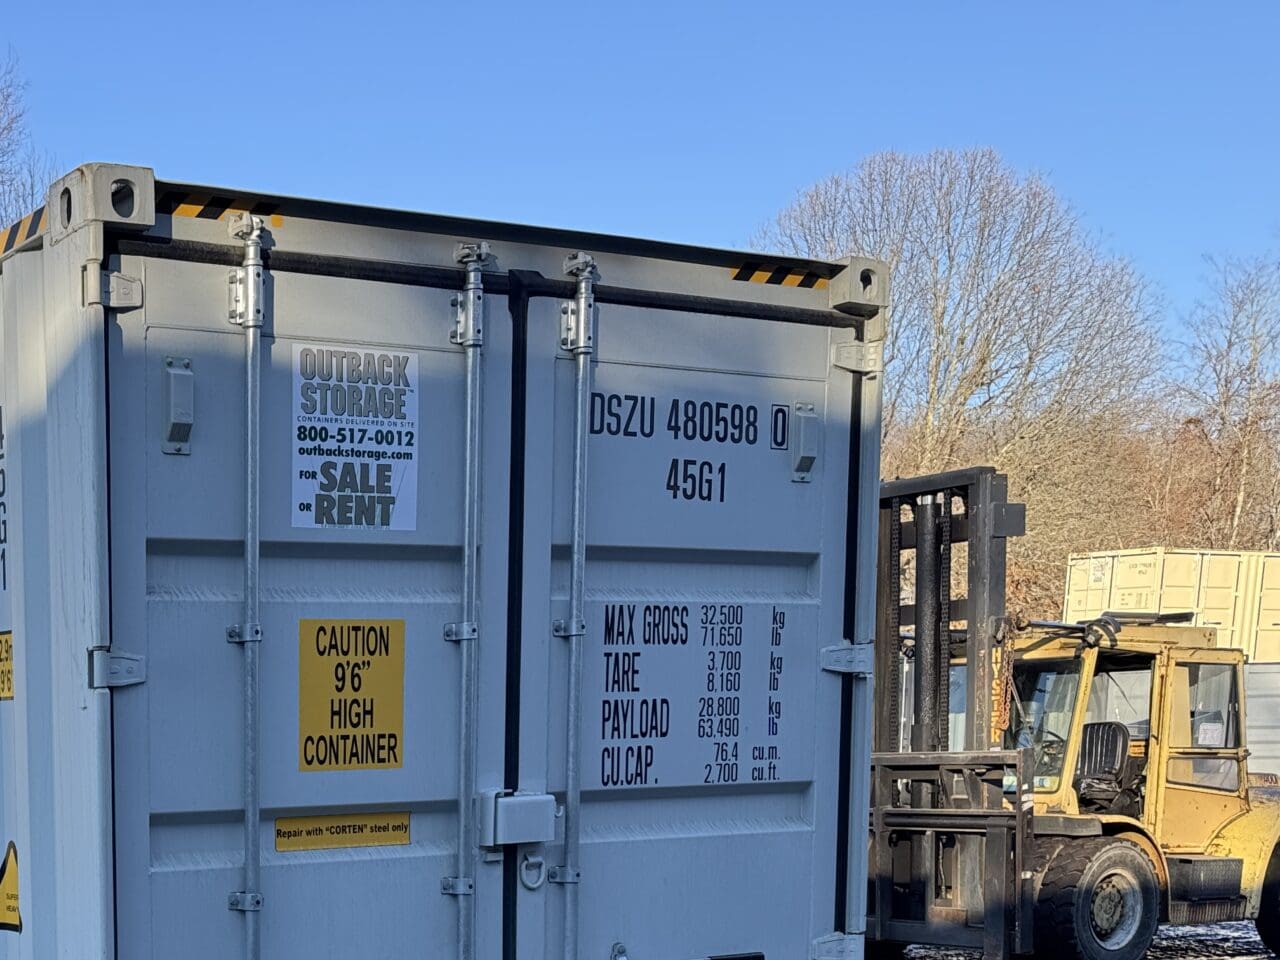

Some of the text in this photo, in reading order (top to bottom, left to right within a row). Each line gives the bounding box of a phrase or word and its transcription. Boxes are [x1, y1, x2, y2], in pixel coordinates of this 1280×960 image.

[299, 347, 411, 387] OUTBACK
[300, 382, 407, 420] STORAGE
[296, 425, 414, 446] 800-517-0012
[297, 416, 343, 424] CONTAINERS
[346, 418, 385, 426] DELIVERED
[589, 392, 788, 448] DSZU 480598 0
[298, 444, 413, 461] outbackstorage.com
[299, 460, 392, 494] FOR SALE
[666, 458, 726, 502] 45G1
[298, 494, 396, 526] OR RENT
[603, 604, 636, 646] MAX
[642, 605, 689, 646] GROSS
[772, 605, 785, 629] kg
[771, 626, 781, 646] lb
[316, 626, 390, 657] CAUTION
[604, 652, 640, 692] TARE
[770, 651, 783, 674] kg
[706, 672, 779, 693] 8,160 lb
[330, 698, 374, 729] HIGH
[601, 698, 670, 740] PAYLOAD
[768, 696, 781, 719] kg
[768, 716, 778, 736] lb
[303, 733, 398, 766] CONTAINER
[713, 742, 738, 762] 76.4
[752, 745, 781, 761] cu.m.
[751, 761, 780, 781] cu.ft.
[276, 828, 304, 840] Repair
[306, 827, 323, 837] with
[370, 823, 390, 833] steel
[392, 822, 409, 834] only
